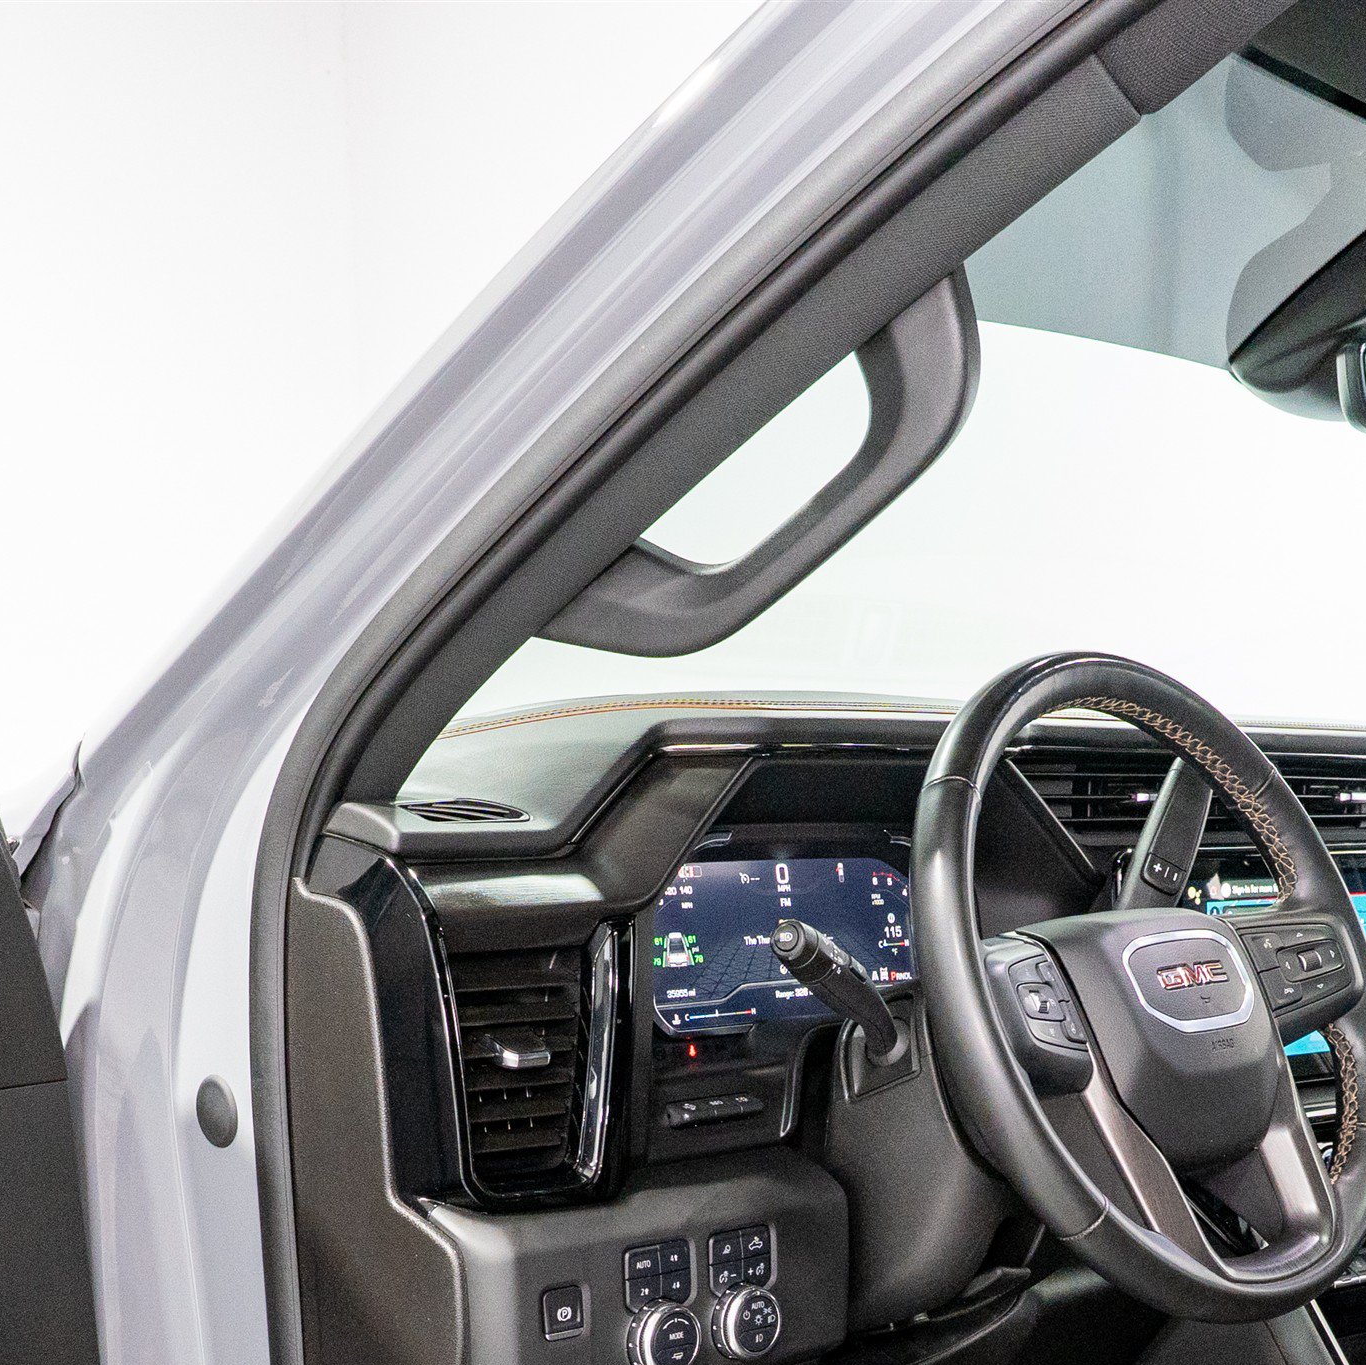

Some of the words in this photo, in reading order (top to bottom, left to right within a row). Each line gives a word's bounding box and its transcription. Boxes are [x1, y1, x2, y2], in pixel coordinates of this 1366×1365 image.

[775, 863, 789, 884] 0
[780, 898, 791, 907] FM
[884, 925, 902, 938] 115
[1157, 960, 1229, 990] GMC
[636, 1260, 651, 1269] AUTO
[751, 1301, 765, 1309] AUTO
[669, 1332, 684, 1340] MODE
